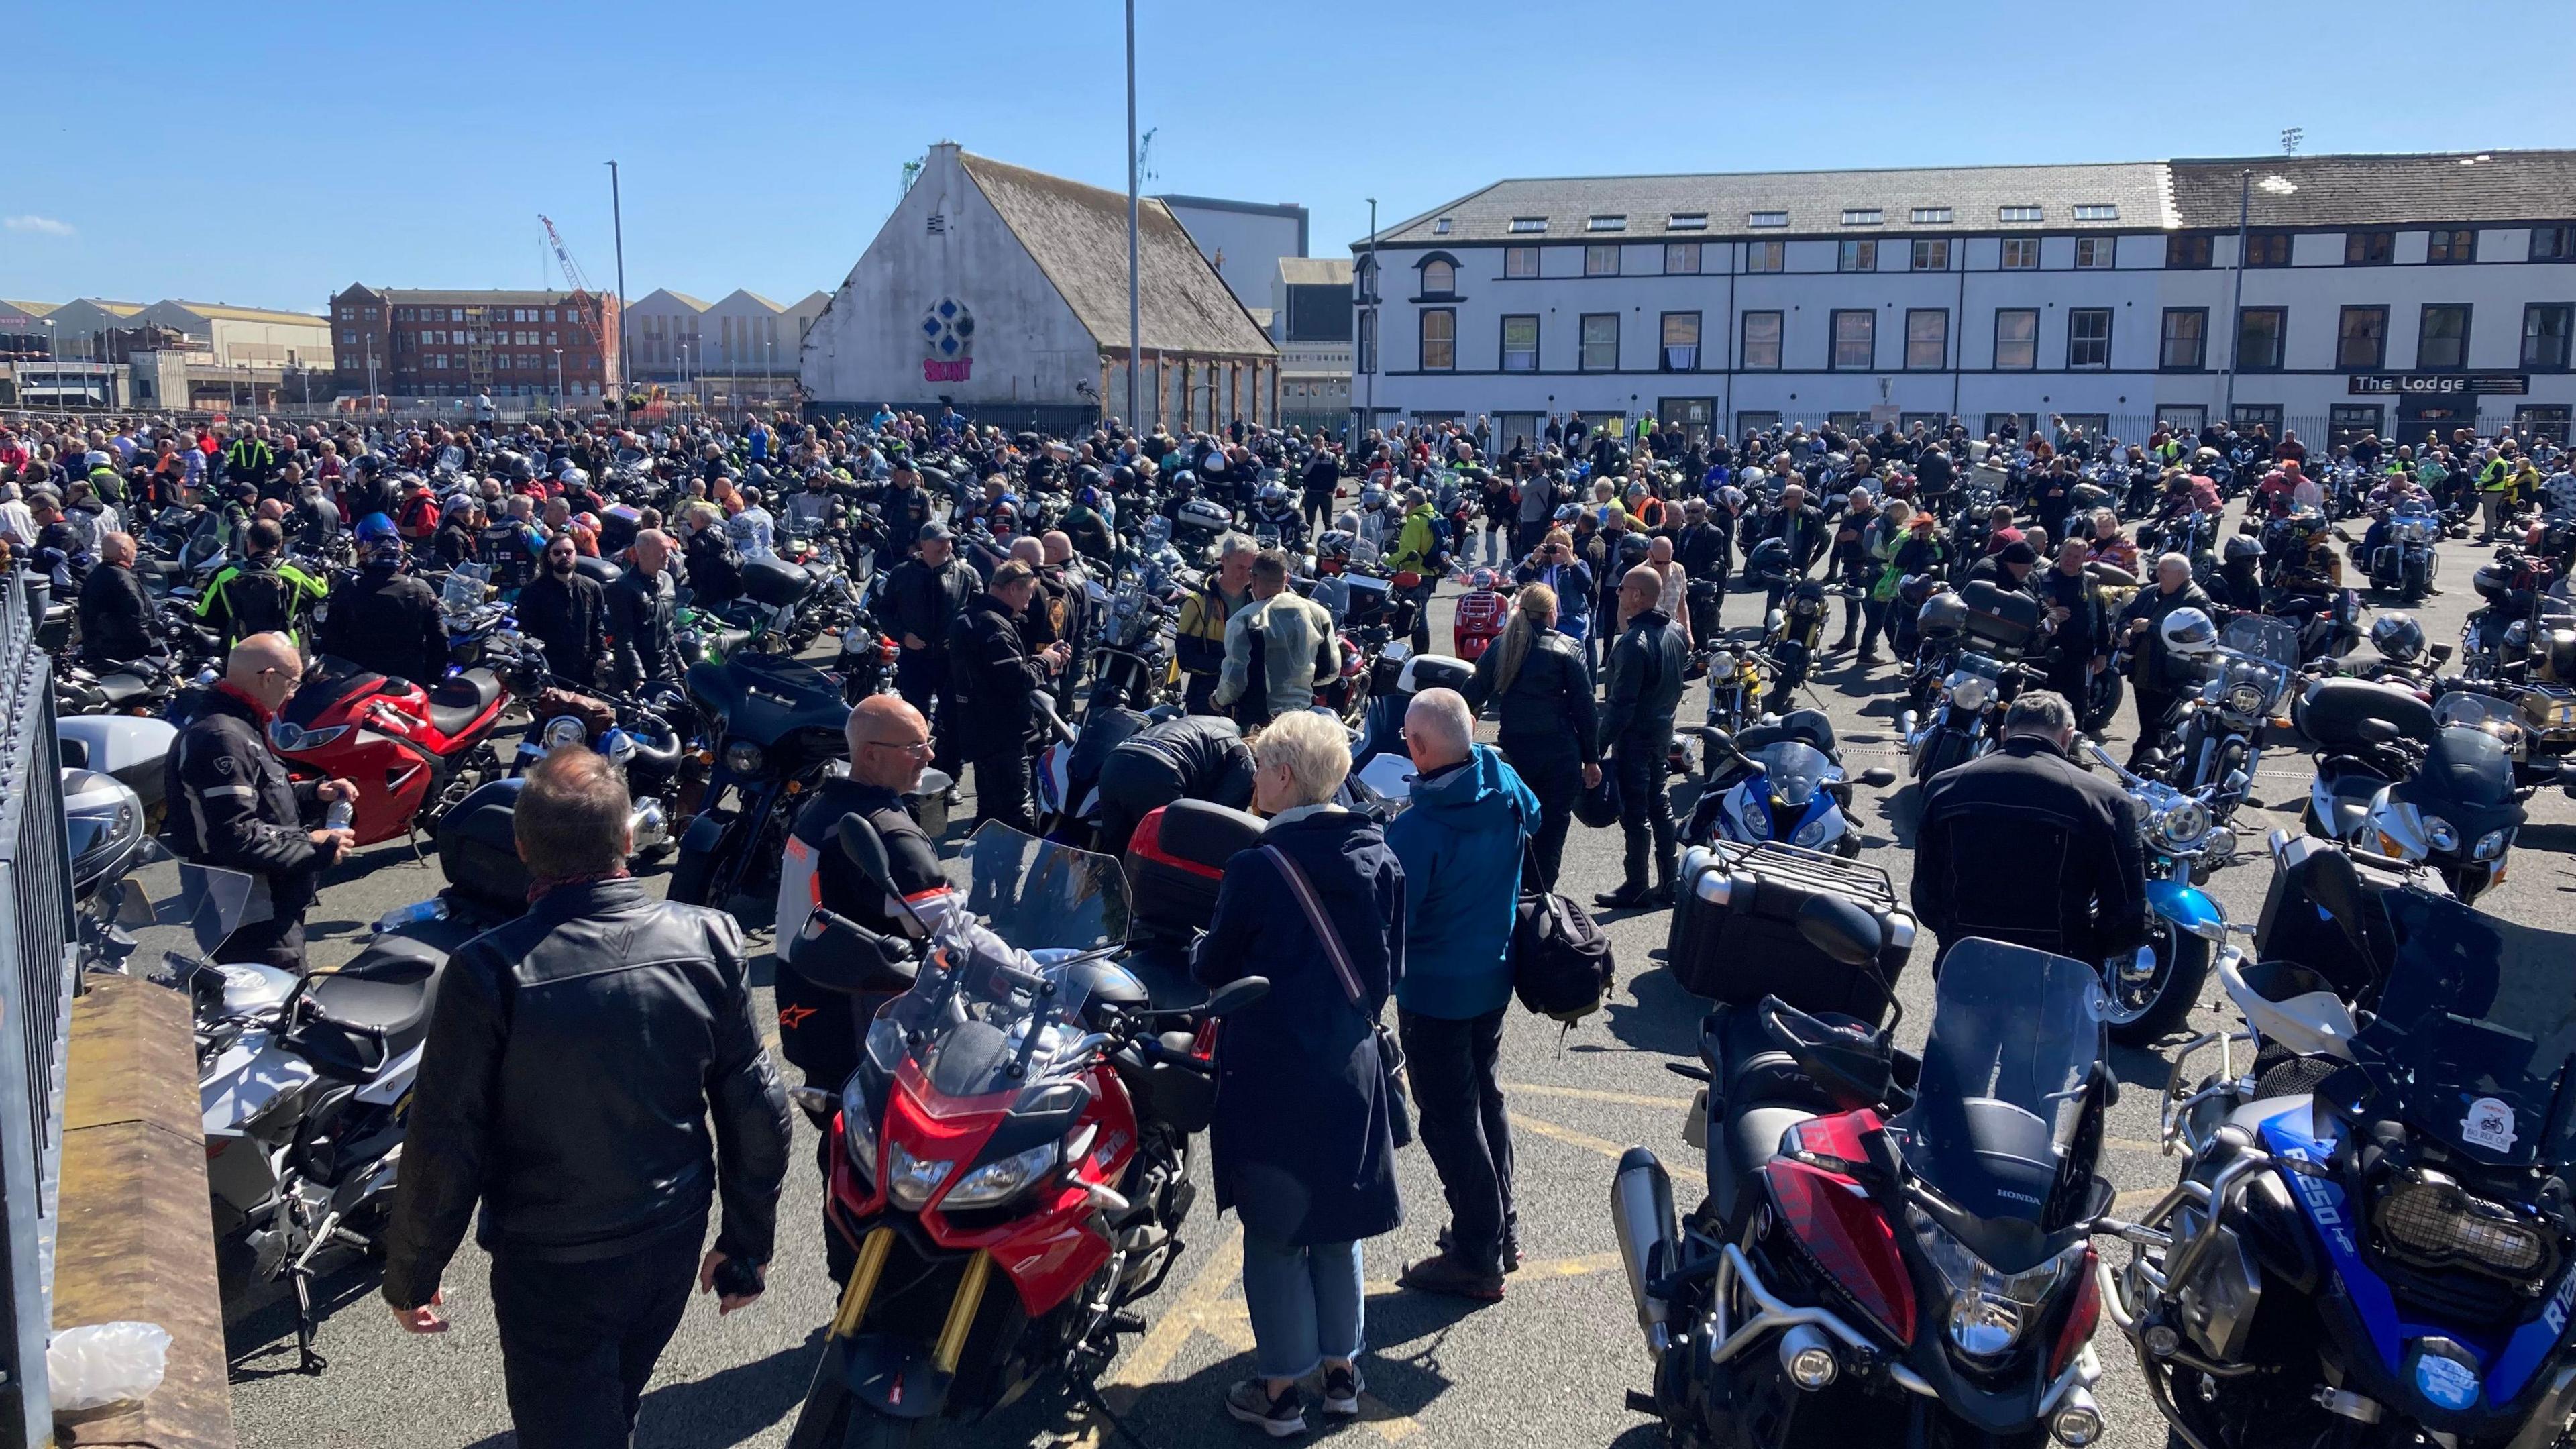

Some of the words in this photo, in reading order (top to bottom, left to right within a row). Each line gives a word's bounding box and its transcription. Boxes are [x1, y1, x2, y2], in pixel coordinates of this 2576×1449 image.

[923, 358, 973, 382] SKINT
[2355, 376, 2392, 390] The
[2402, 376, 2465, 393] Lodge
[1997, 1189, 2041, 1205] HONDA
